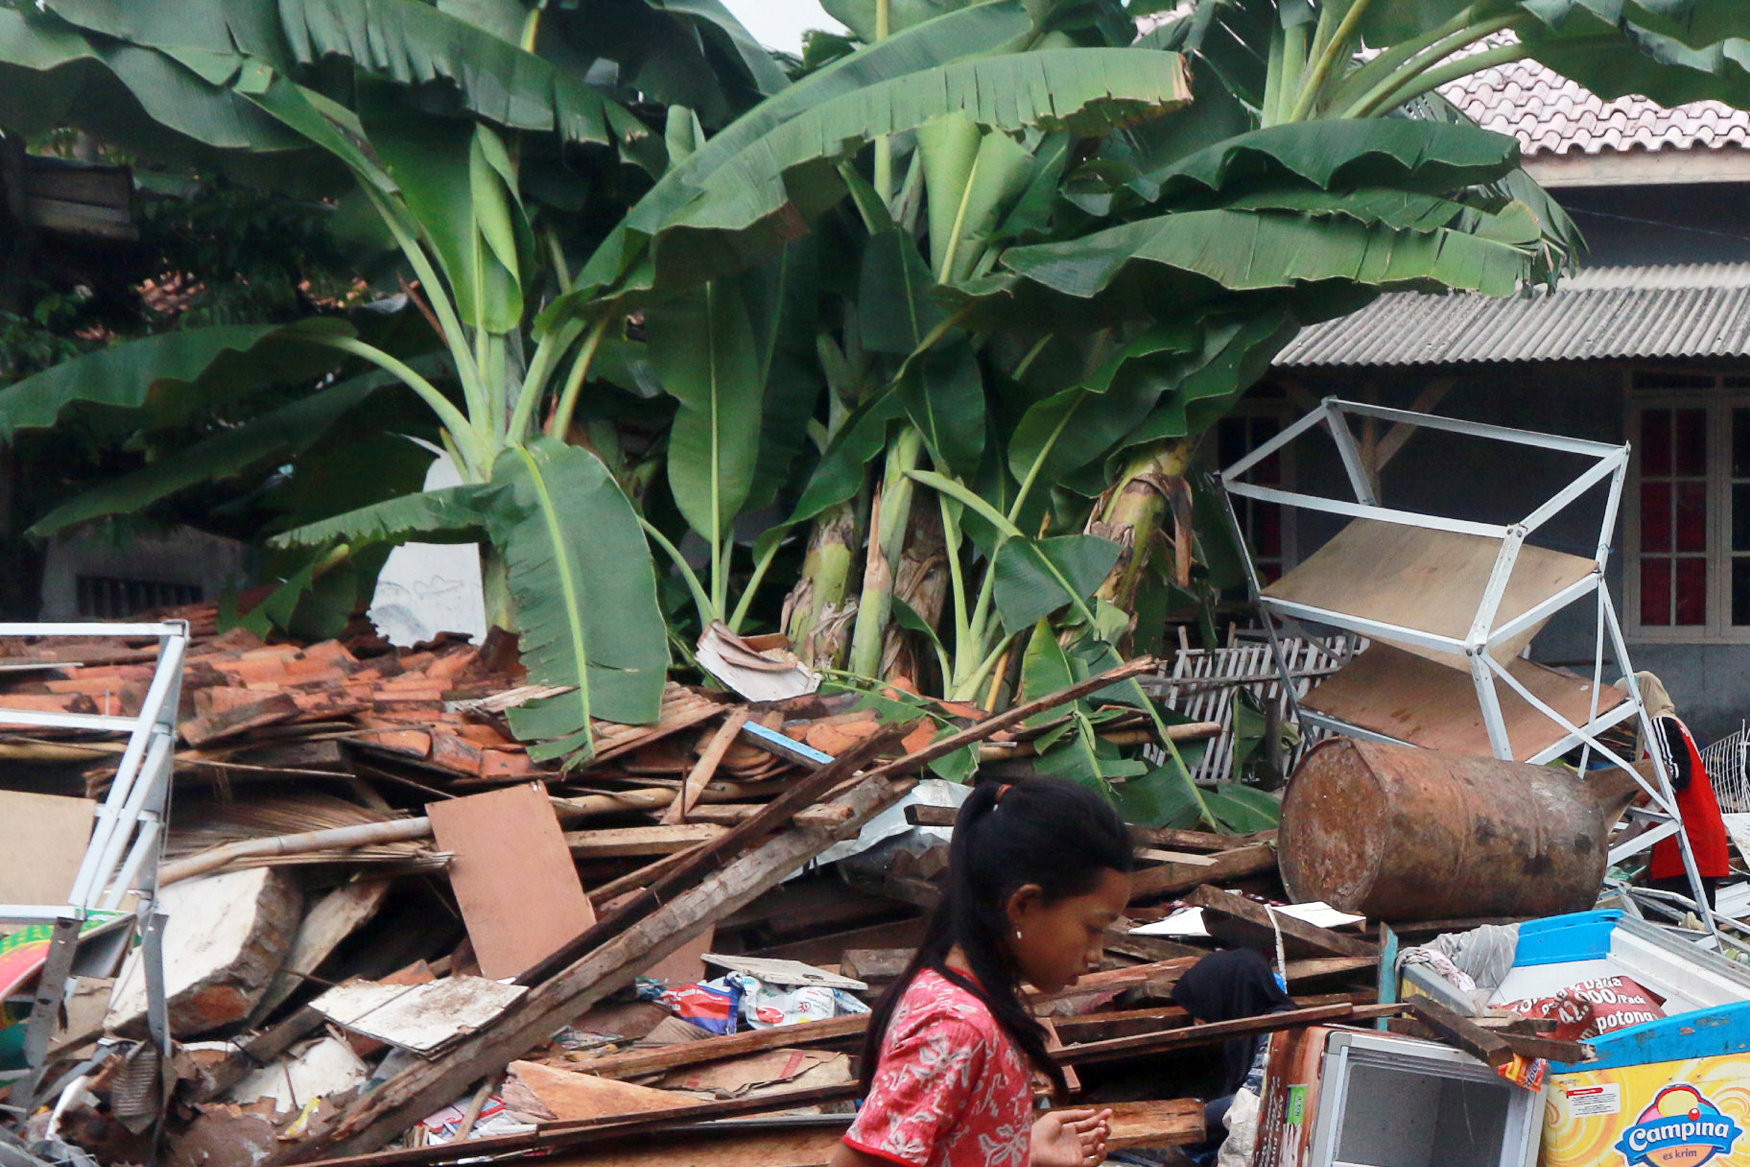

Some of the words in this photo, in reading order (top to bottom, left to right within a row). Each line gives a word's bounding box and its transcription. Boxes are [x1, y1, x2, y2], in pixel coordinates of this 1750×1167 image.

[1628, 1121, 1729, 1151] Campina
[1662, 1152, 1674, 1161] es
[1675, 1149, 1697, 1158] krim
